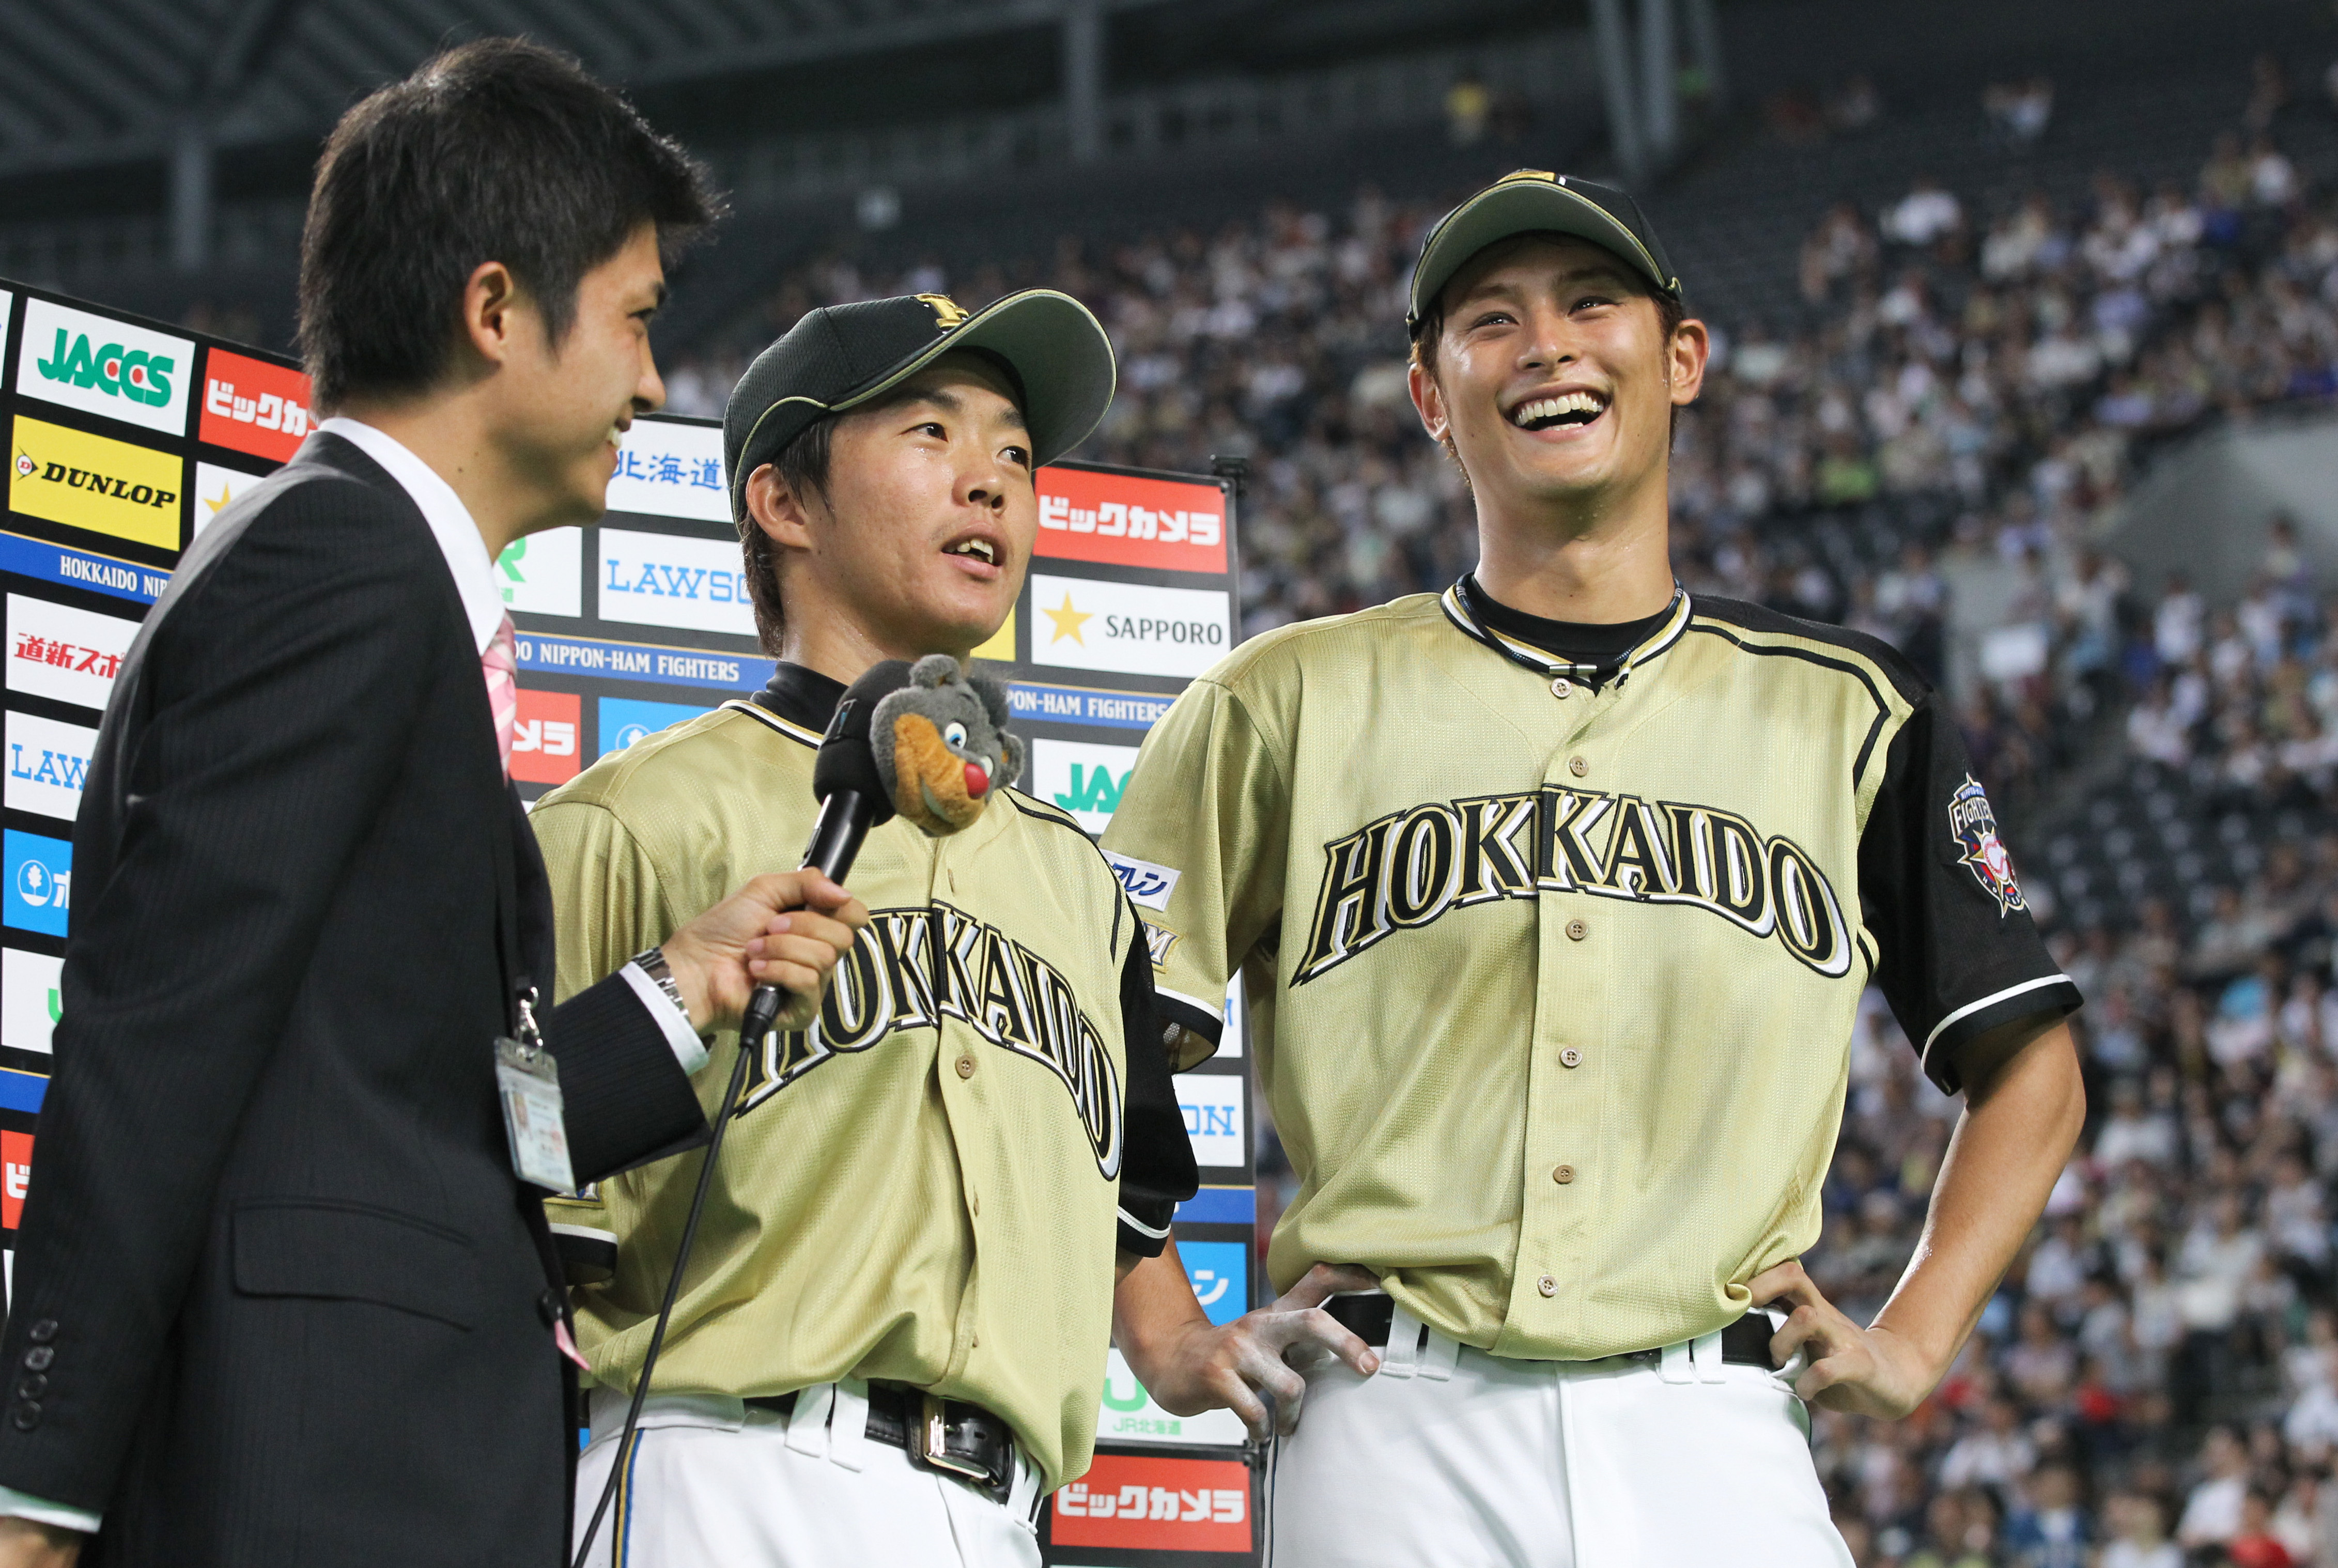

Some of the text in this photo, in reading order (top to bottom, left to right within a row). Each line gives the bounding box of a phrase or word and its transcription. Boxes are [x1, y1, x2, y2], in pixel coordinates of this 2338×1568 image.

[38, 328, 175, 408] JACCS
[207, 378, 307, 437] ビックカ
[41, 462, 176, 509] DUNLOP
[611, 450, 729, 490] 北海道
[1039, 494, 1220, 546] ビックカメラ
[60, 555, 171, 597] HOKKAIDO NIP
[1106, 614, 1222, 645] SAPPORO
[540, 643, 651, 673] NIPPON-HAM
[657, 655, 740, 682] FIGHTERS
[1054, 763, 1134, 813] JA
[1289, 783, 1853, 988] HOKKAIDO
[1057, 1482, 1246, 1524] ビックカメラ
